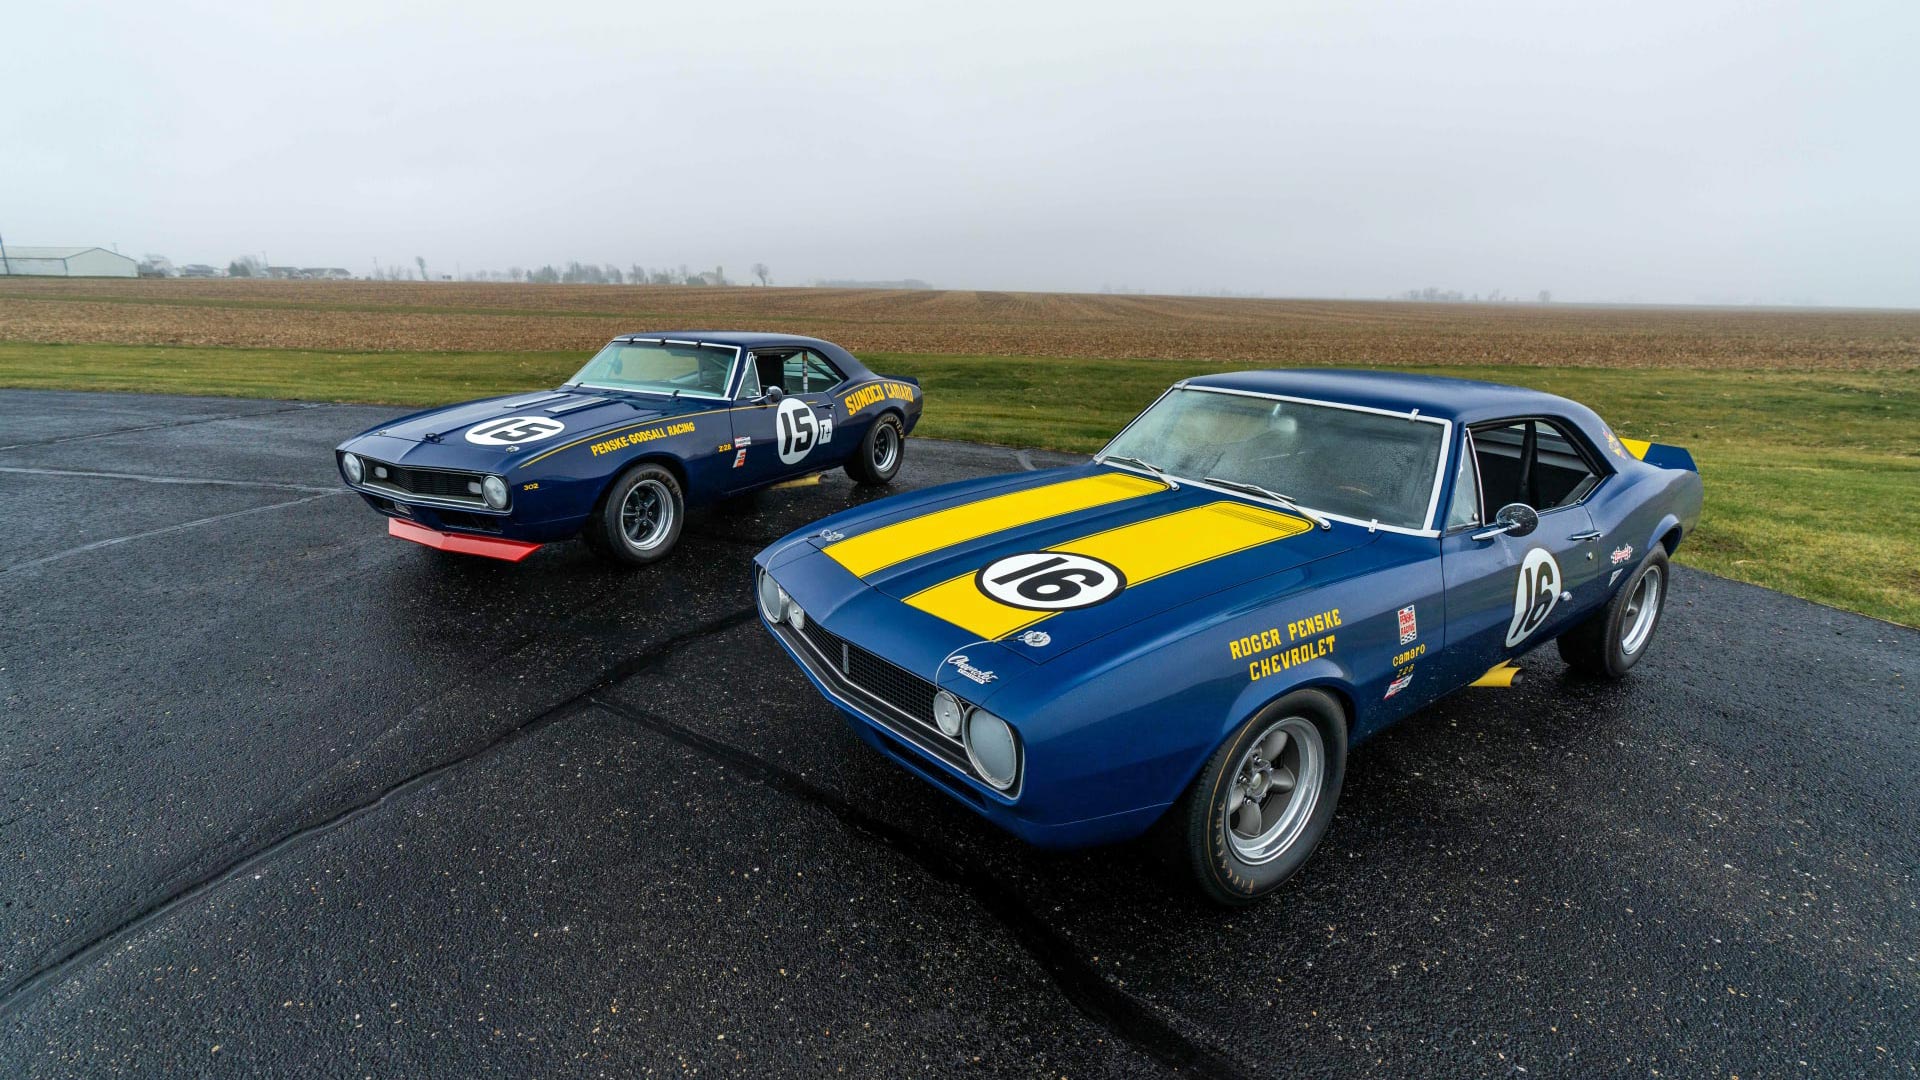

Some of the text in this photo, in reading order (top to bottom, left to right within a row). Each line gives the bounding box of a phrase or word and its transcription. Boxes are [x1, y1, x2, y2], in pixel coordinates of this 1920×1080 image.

[845, 384, 885, 416] SUNOCO
[472, 418, 561, 442] 15
[590, 421, 696, 456] PENSKE-GODSALL RACING
[780, 407, 813, 456] 15
[523, 482, 539, 491] 302
[990, 556, 1105, 602] 16
[1510, 561, 1554, 640] 16
[1229, 608, 1342, 660] ROGER PENSKE
[1249, 634, 1336, 681] CHEVROLET
